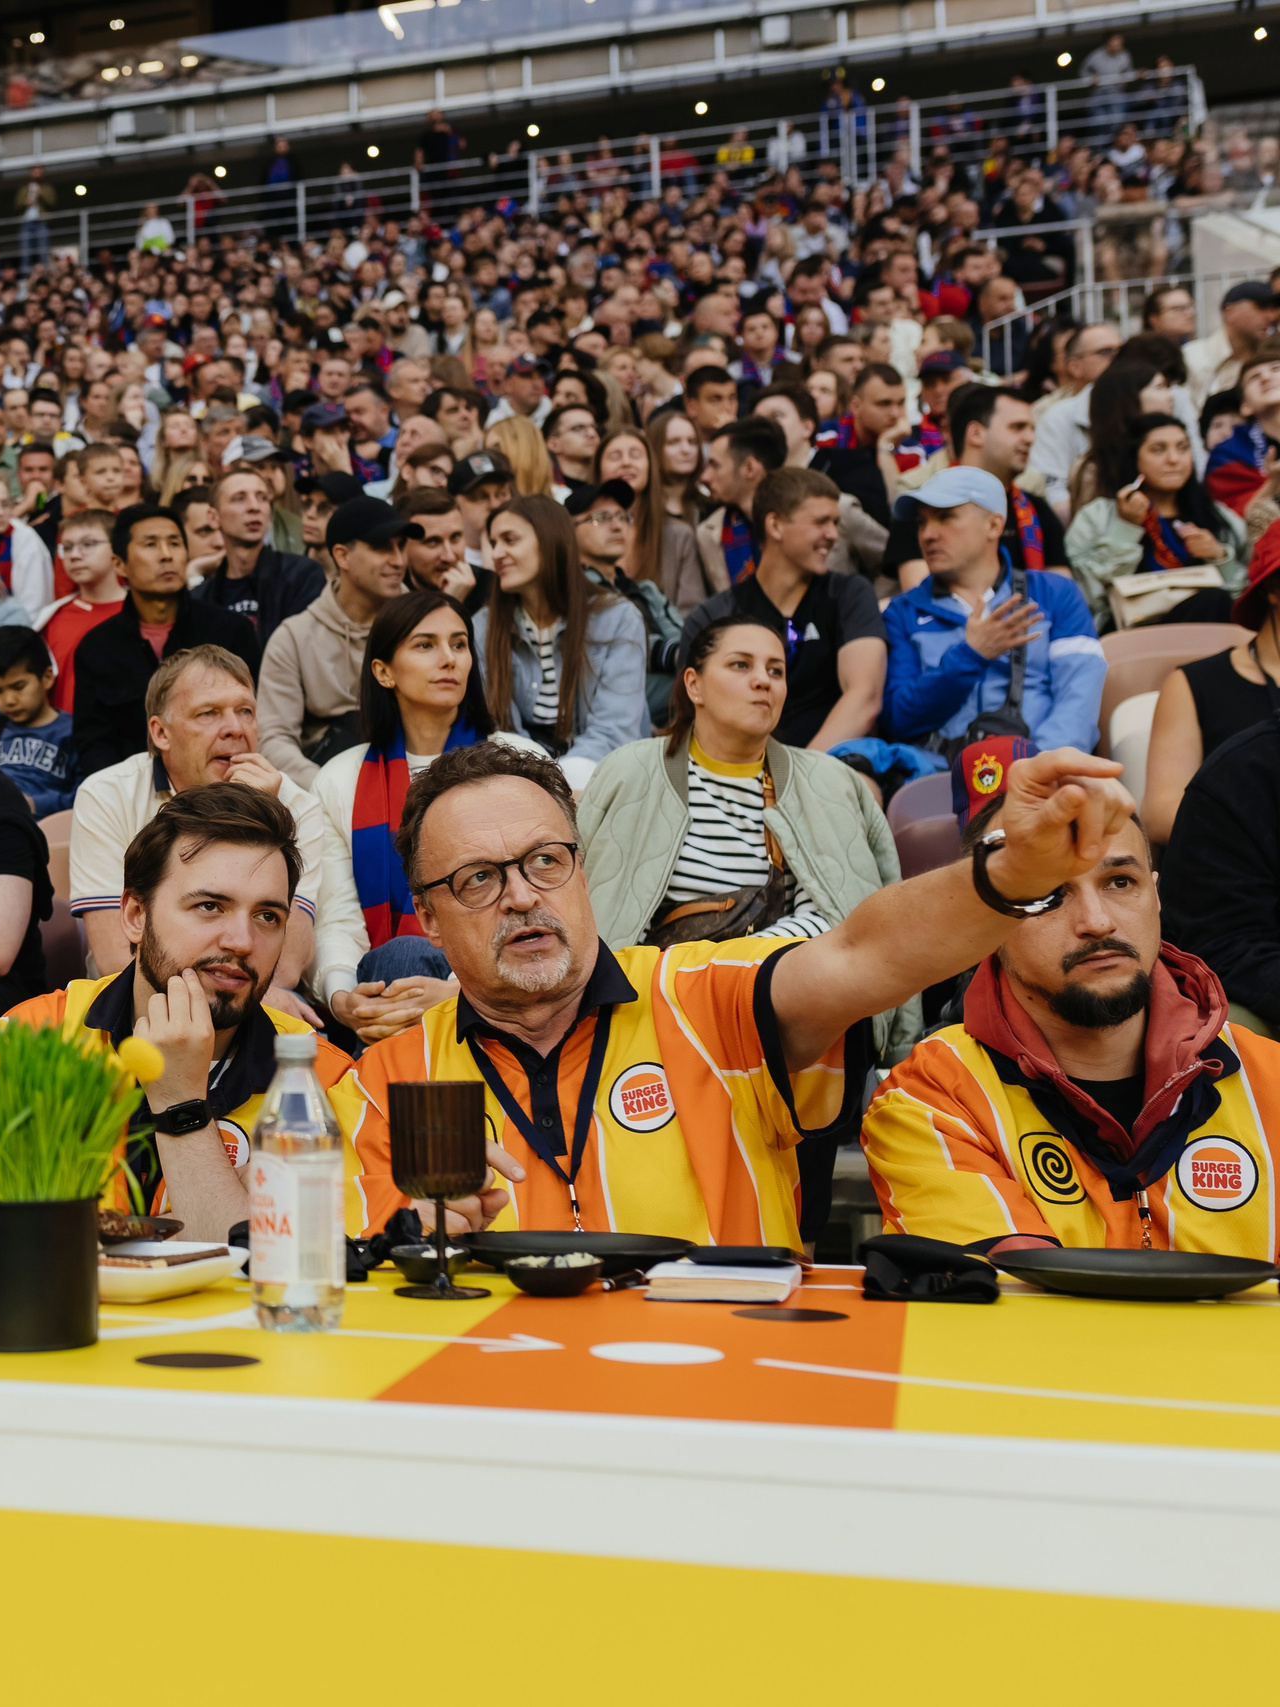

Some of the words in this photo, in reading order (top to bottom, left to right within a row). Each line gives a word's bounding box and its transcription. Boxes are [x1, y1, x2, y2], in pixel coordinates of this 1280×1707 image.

[621, 1083, 665, 1102] BURGER
[623, 1093, 668, 1115] KING
[1192, 1162, 1242, 1174] BURGER
[1192, 1173, 1242, 1189] KING
